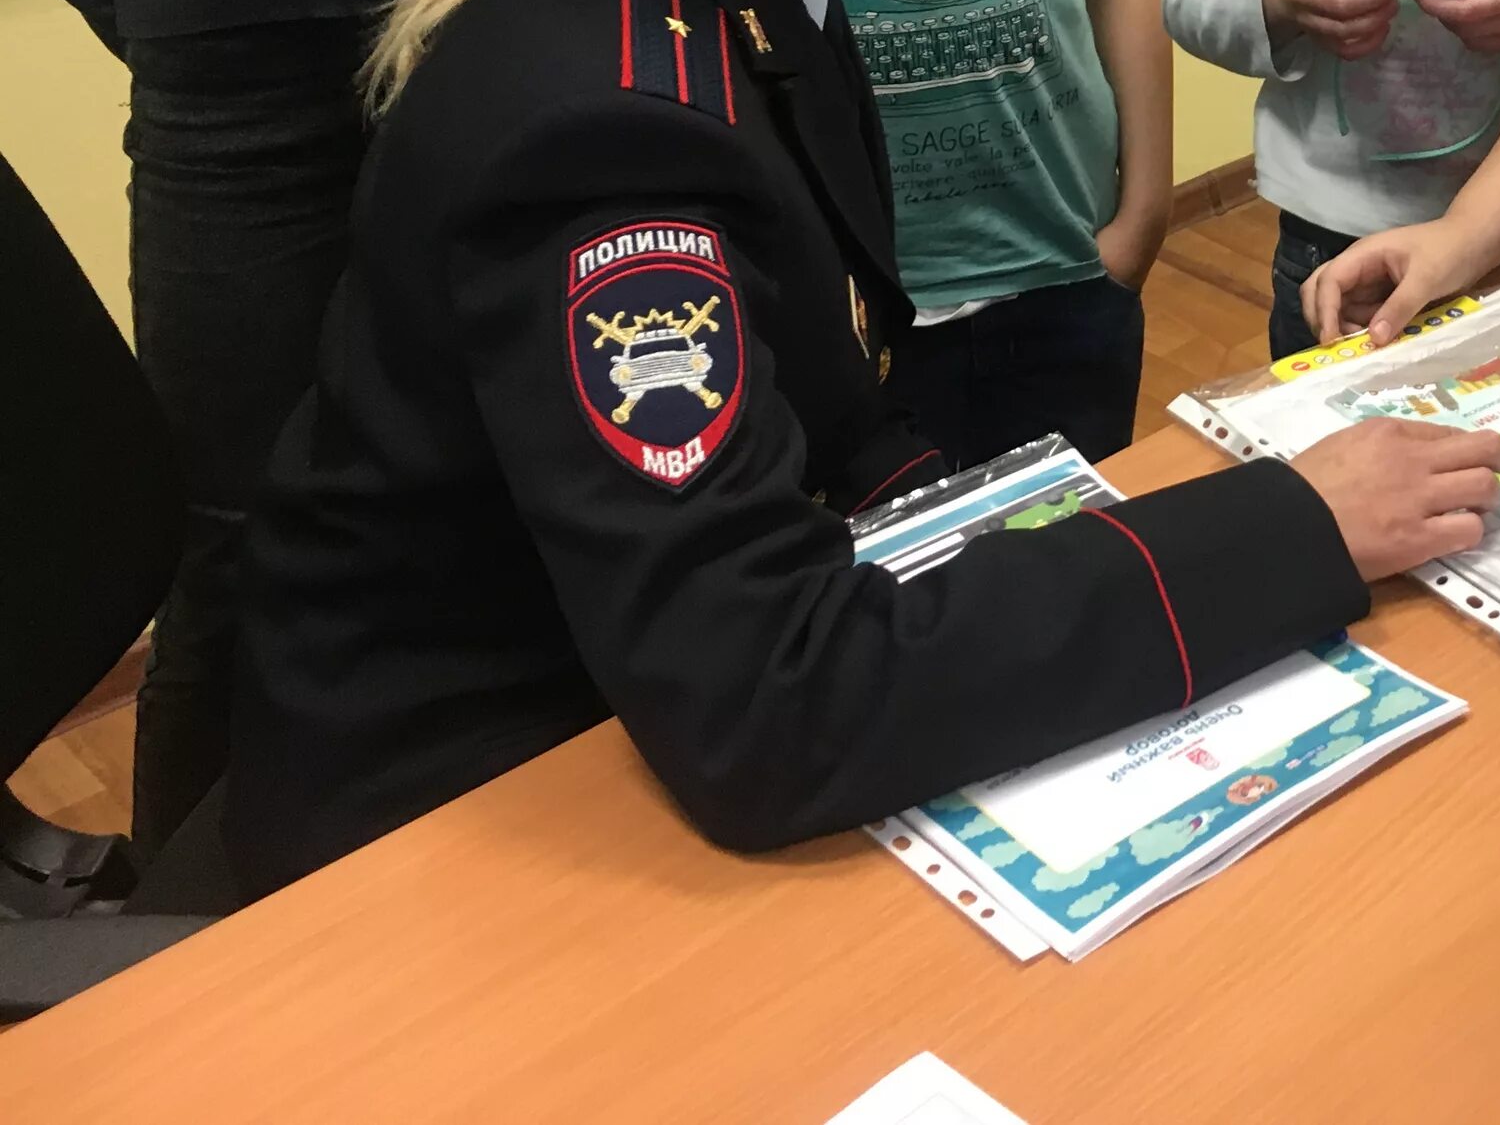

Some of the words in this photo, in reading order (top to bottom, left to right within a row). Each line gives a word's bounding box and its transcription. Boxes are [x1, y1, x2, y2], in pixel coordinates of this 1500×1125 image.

[902, 120, 990, 157] SAGGE
[579, 230, 715, 278] ПОЛИЦИЯ
[642, 435, 706, 479] МВД
[1125, 709, 1200, 757] договор
[1184, 704, 1243, 736] Очень
[1106, 735, 1184, 784] важный
